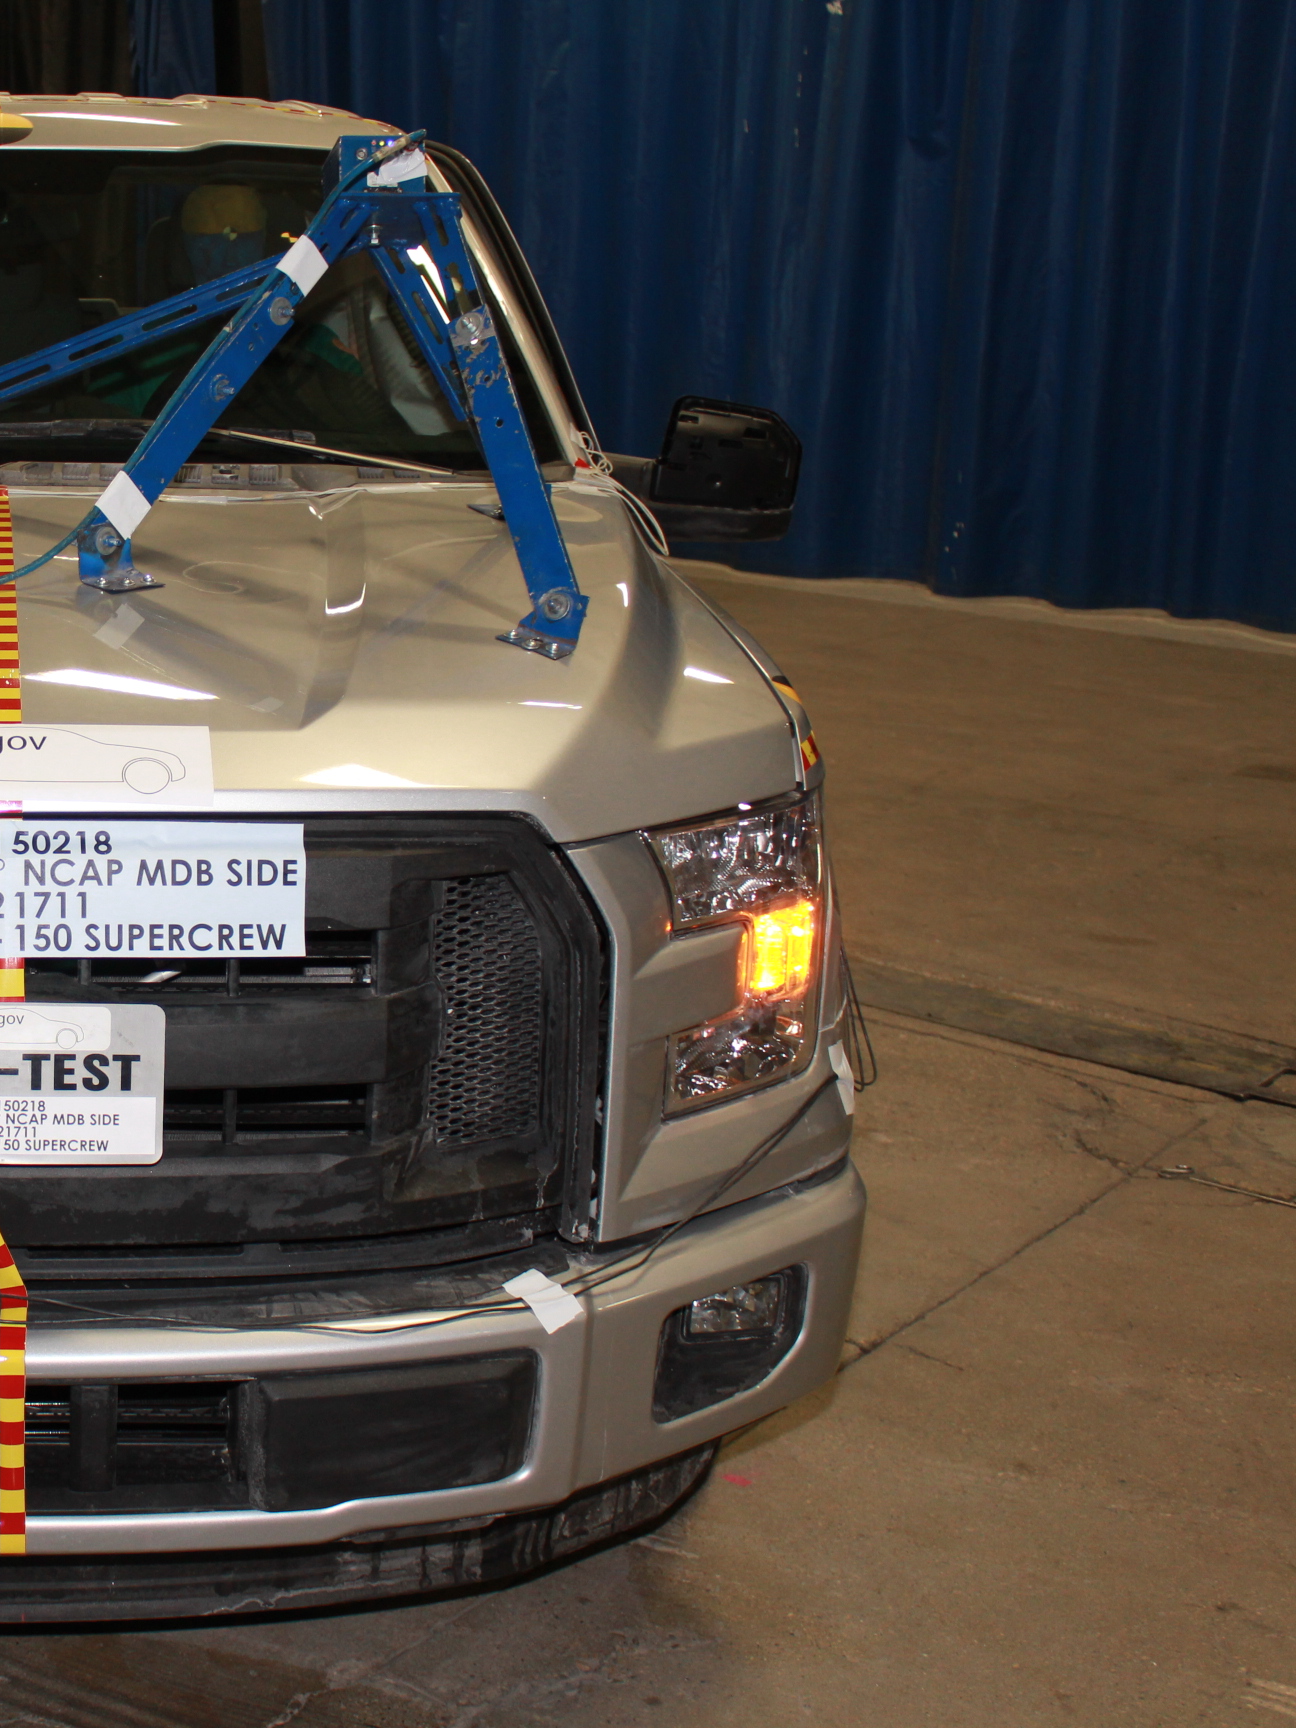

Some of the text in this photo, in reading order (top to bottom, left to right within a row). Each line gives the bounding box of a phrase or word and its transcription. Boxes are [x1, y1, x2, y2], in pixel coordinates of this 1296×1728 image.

[23, 858, 124, 887] NCAP
[136, 859, 214, 887] MDB
[226, 858, 298, 887] SIDE
[84, 923, 287, 952] SUPERCREW
[5, 1113, 48, 1126] NCAP
[52, 1114, 86, 1126] MDB
[90, 1114, 121, 1126] SIDE
[24, 1139, 110, 1152] SUPERCREW
